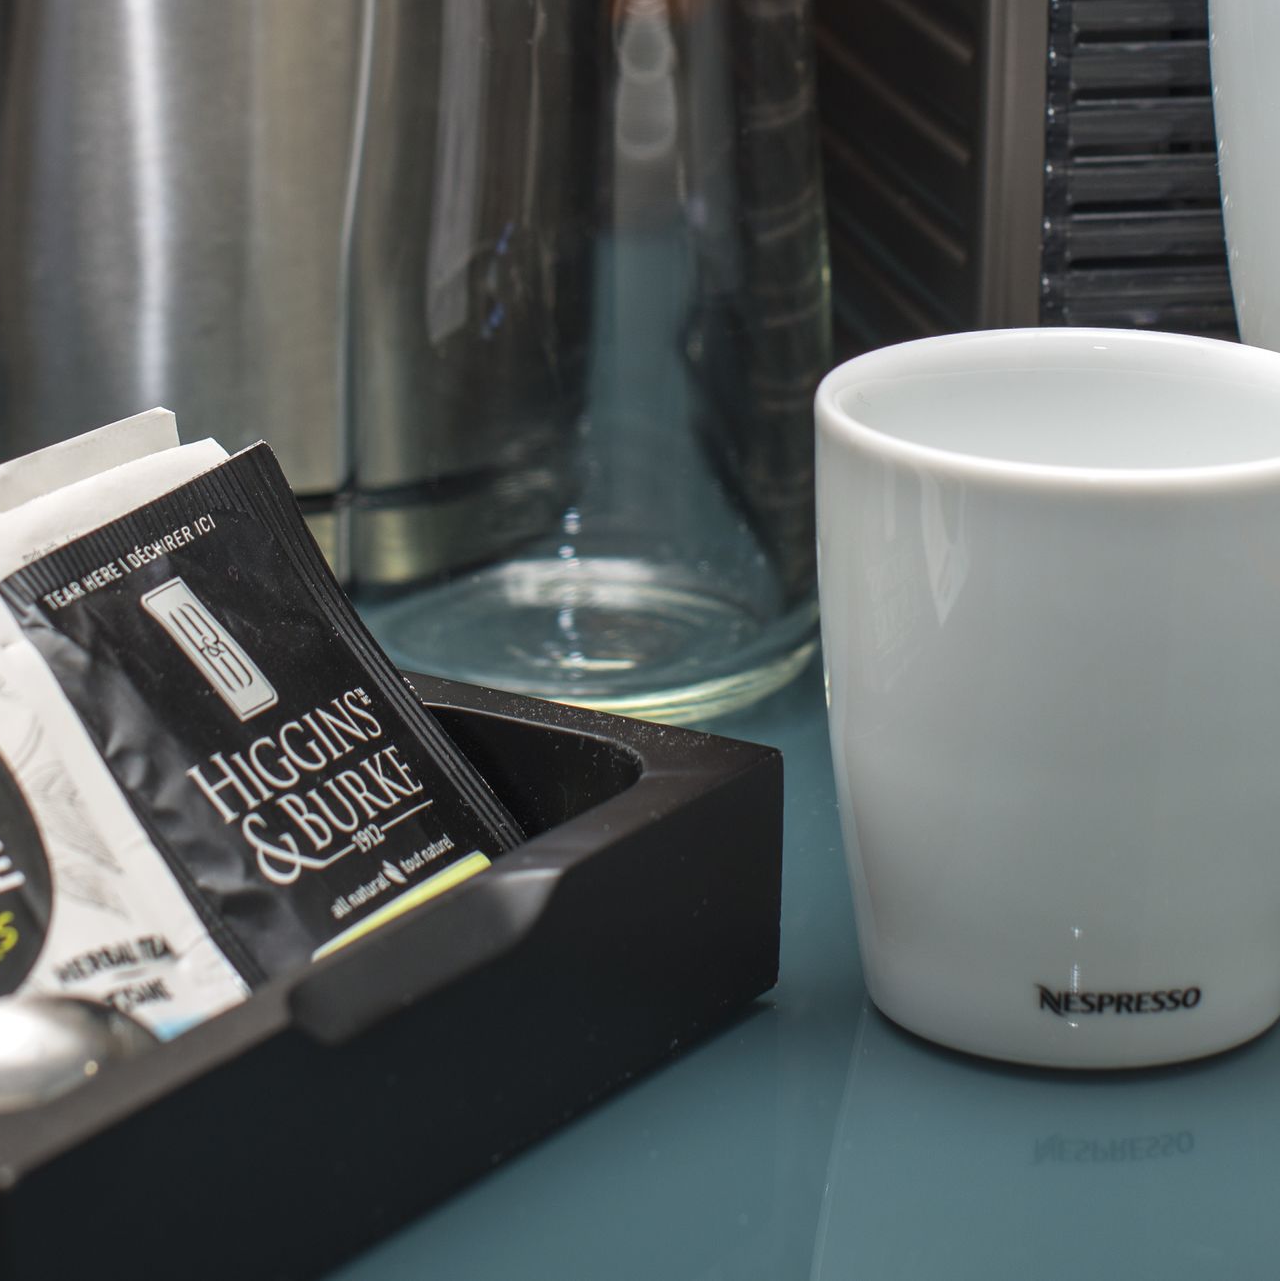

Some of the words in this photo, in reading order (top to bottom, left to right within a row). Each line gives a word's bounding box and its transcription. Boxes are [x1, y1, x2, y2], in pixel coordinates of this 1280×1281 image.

[42, 580, 87, 611] TEAR
[81, 561, 124, 593] HERE
[193, 513, 217, 537] ICI
[184, 688, 384, 825] HIGGINS
[330, 893, 353, 920] all
[346, 870, 393, 906] natural
[399, 850, 426, 875] tout
[420, 832, 456, 864] naturel
[350, 822, 387, 855] 1912
[1033, 982, 1203, 1019] NESPRESSO
